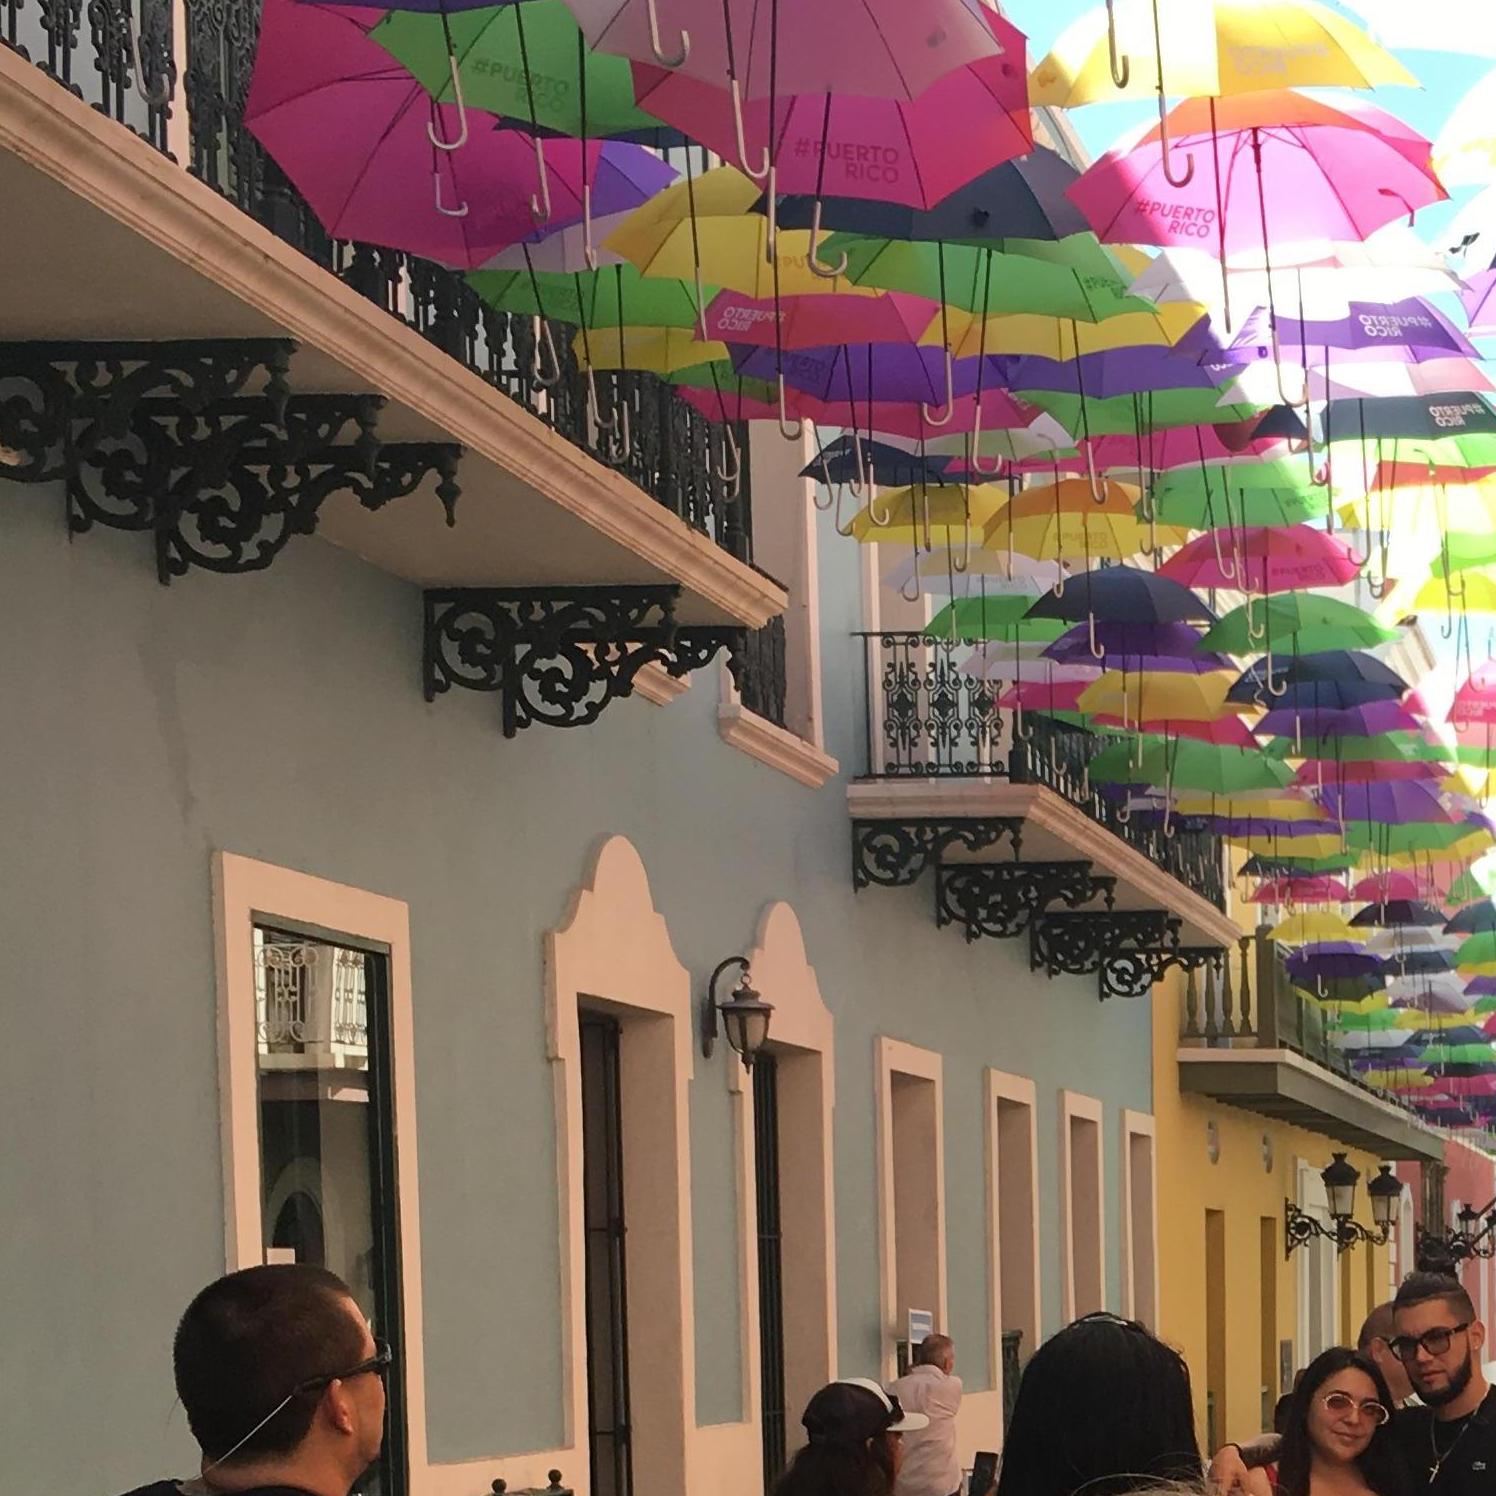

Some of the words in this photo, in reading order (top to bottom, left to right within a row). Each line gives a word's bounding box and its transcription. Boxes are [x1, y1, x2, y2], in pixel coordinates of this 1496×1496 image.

[515, 88, 565, 113] RCO
[794, 138, 899, 165] #PUERTO
[846, 162, 899, 184] RICO
[1135, 199, 1216, 224] #PUERTO
[1168, 220, 1210, 238] RICO
